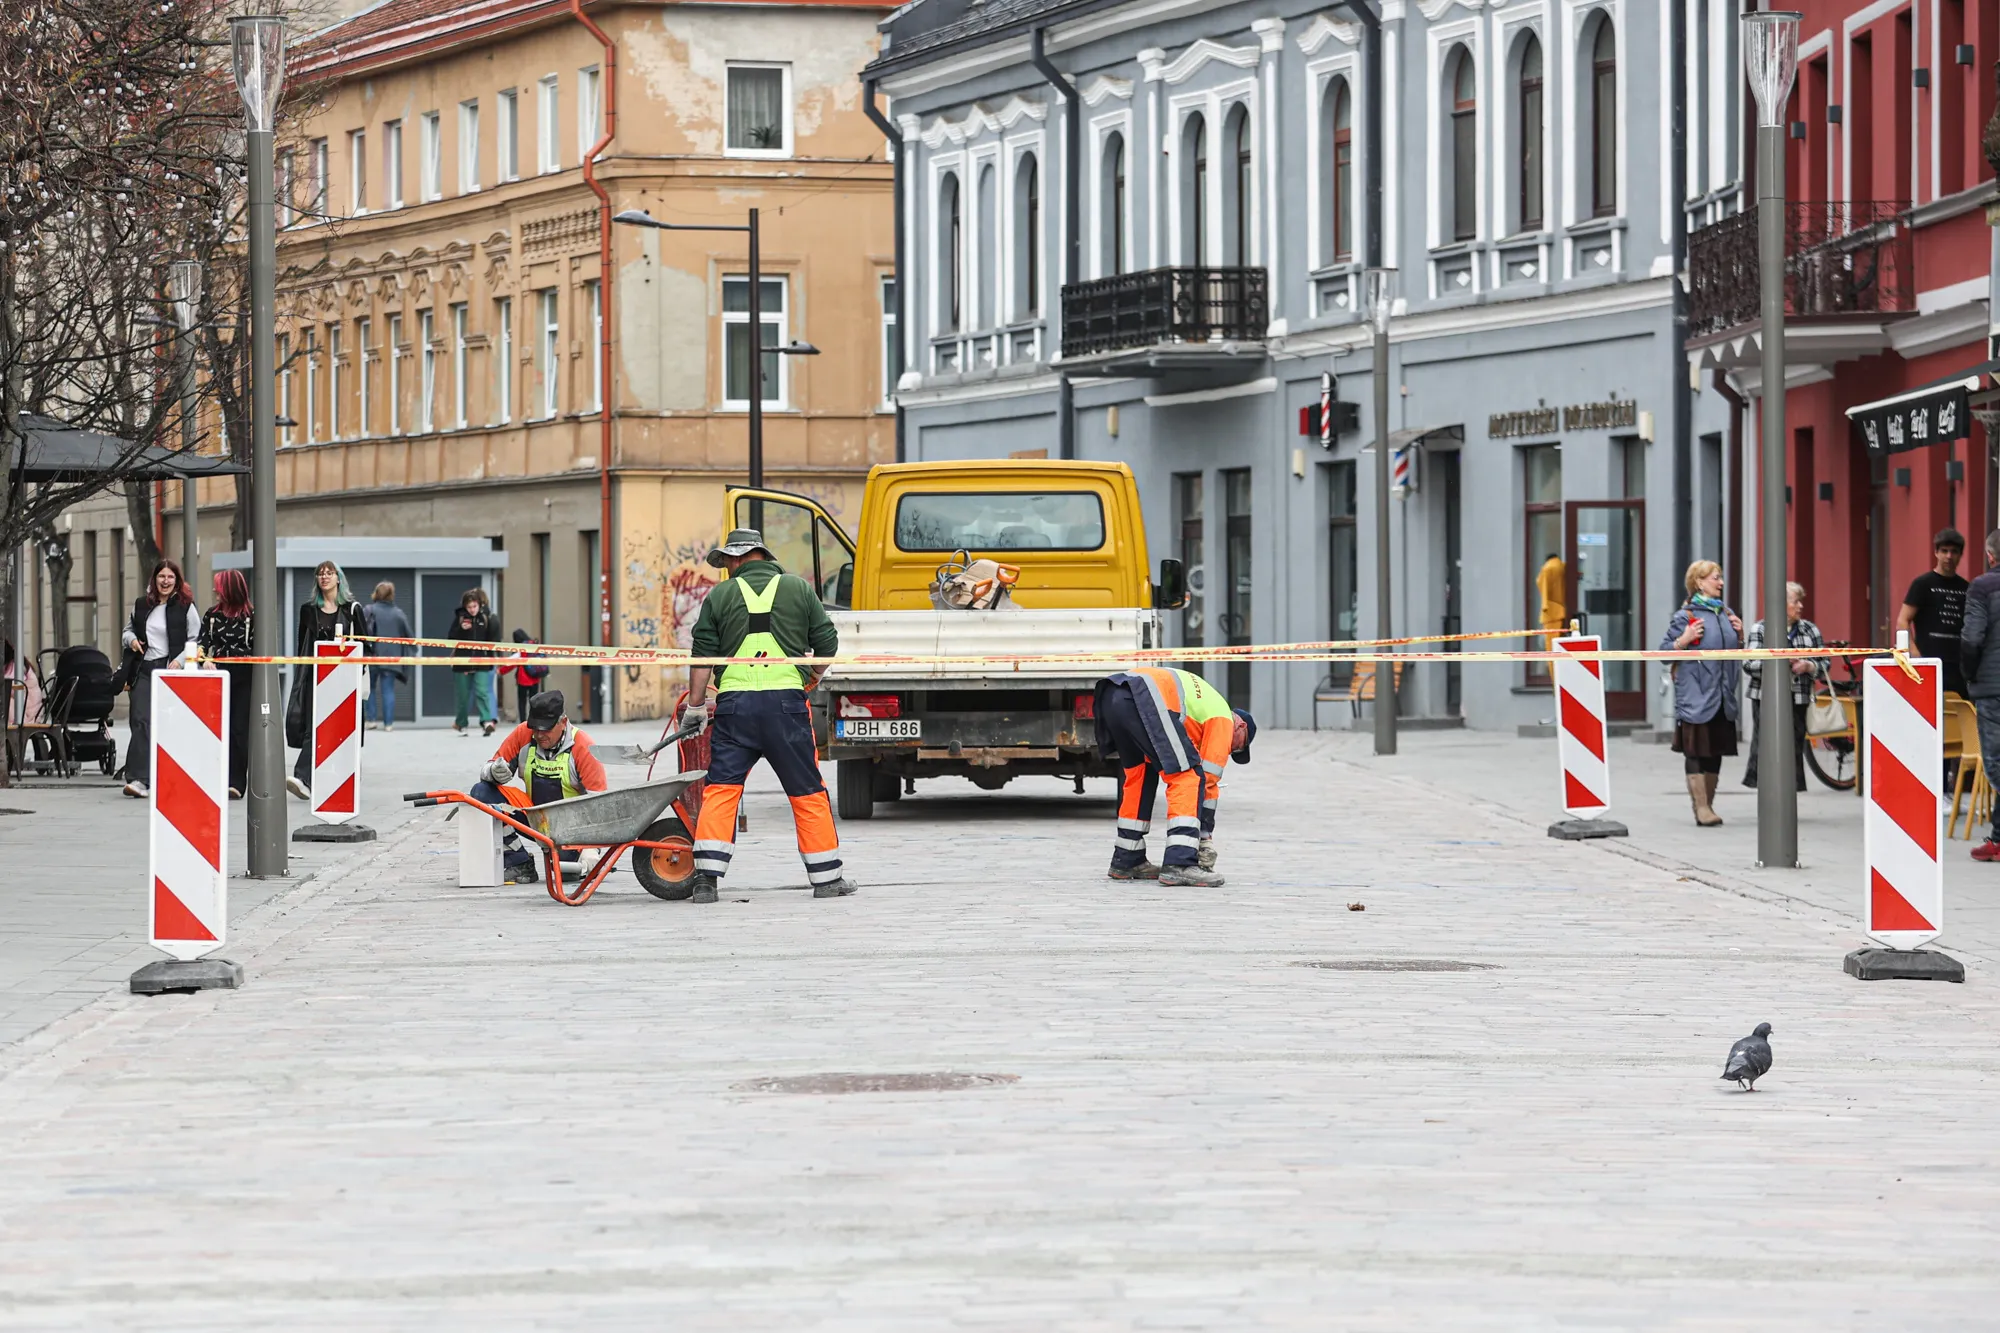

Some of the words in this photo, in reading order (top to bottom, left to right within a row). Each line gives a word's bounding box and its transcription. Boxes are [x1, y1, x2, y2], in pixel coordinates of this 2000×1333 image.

[537, 648, 570, 656] STOP
[846, 722, 879, 736] JBH
[890, 722, 918, 736] 686
